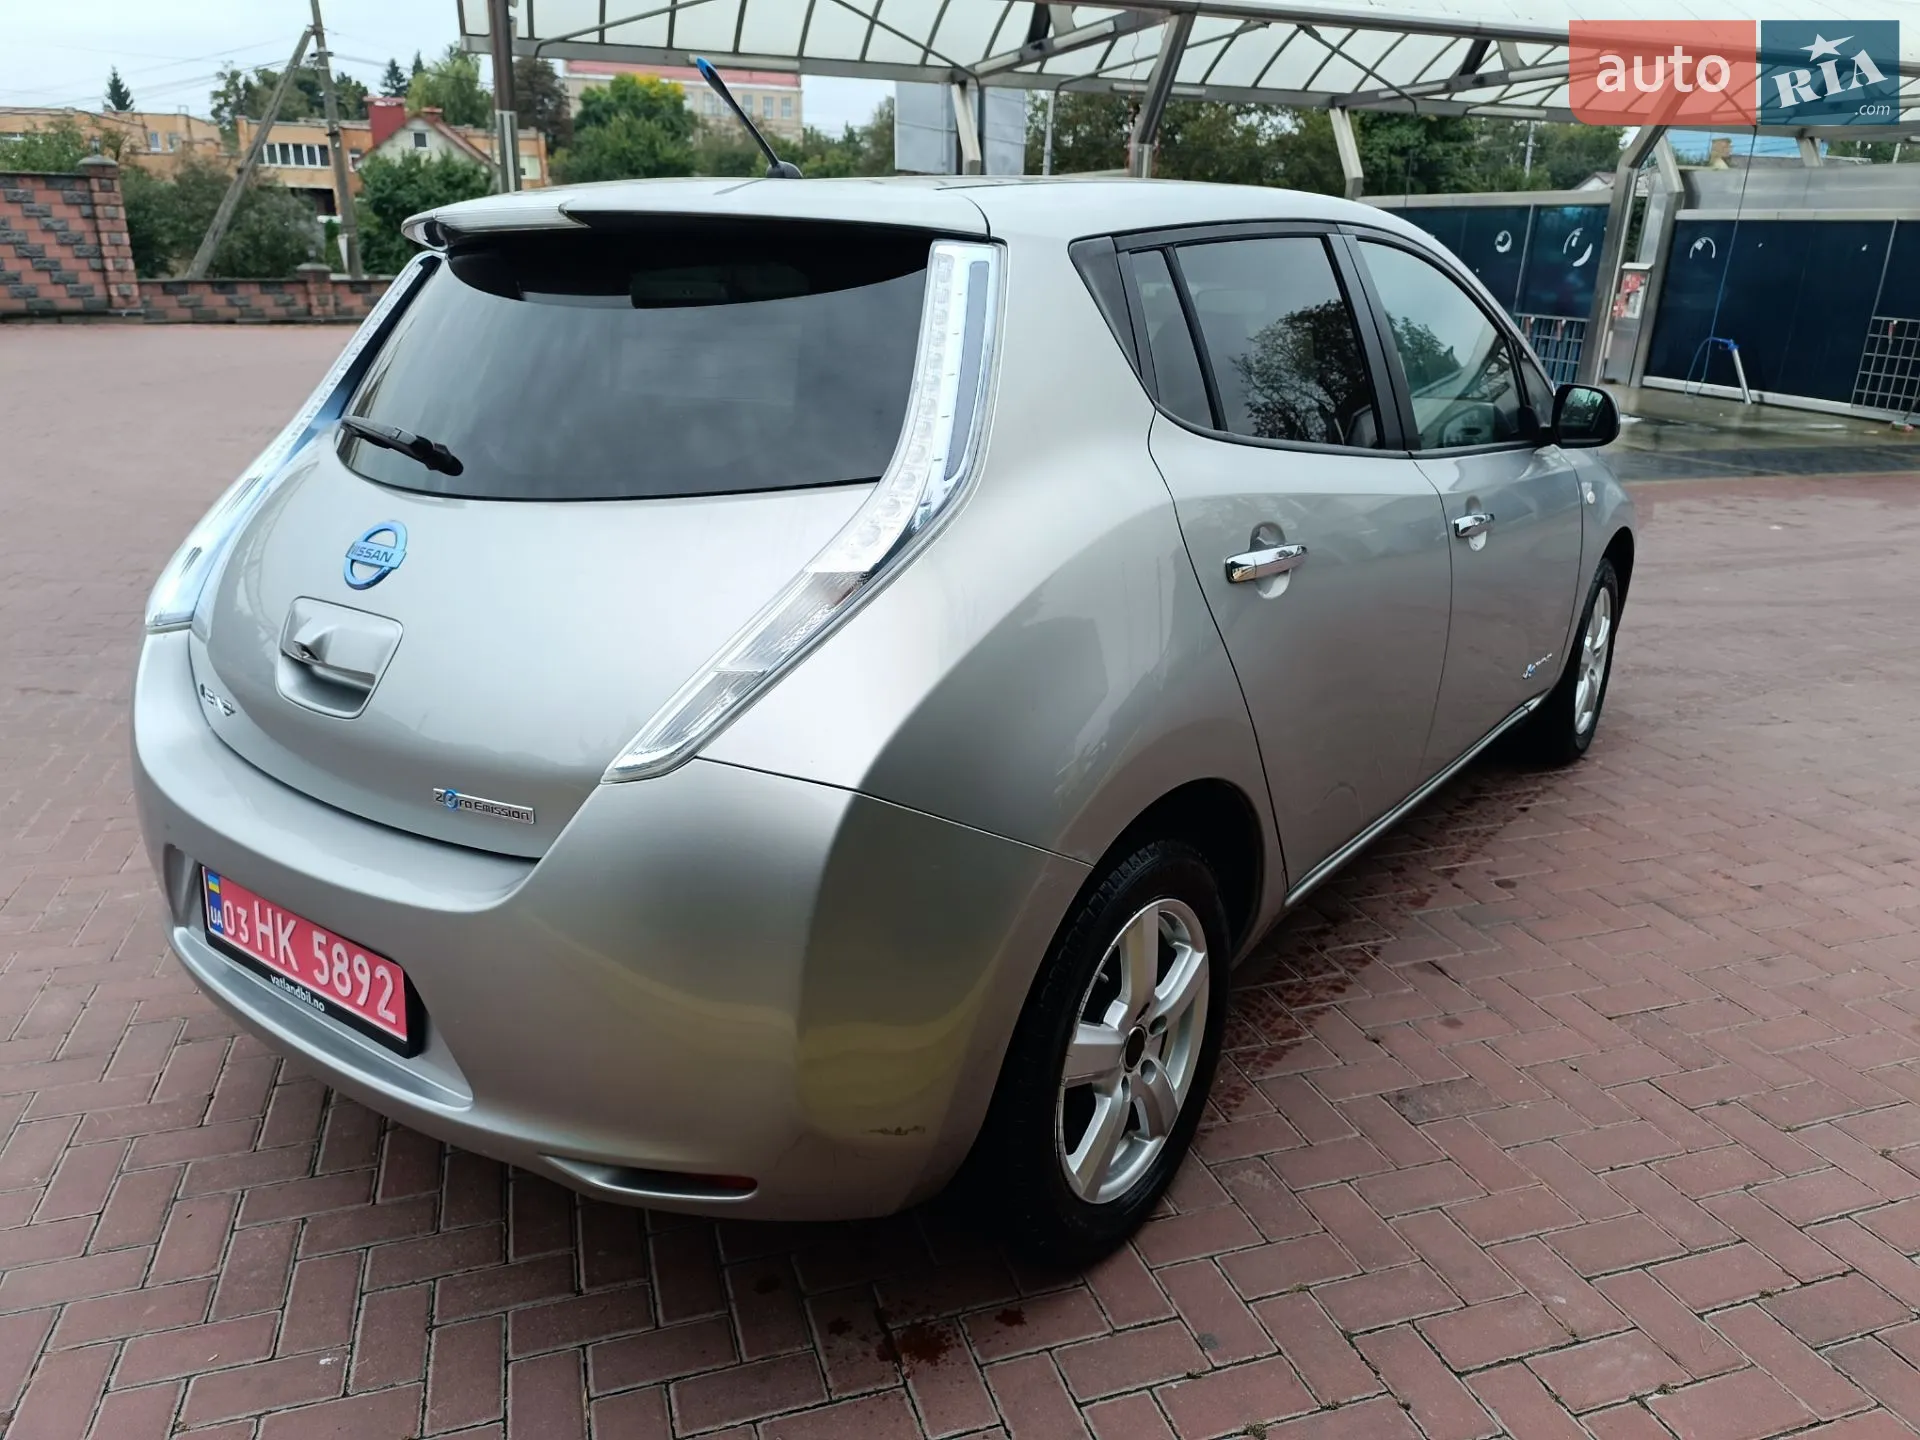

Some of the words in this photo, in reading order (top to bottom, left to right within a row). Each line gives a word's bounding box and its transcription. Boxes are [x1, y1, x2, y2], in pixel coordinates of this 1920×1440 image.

[351, 546, 394, 563] NISSAN
[210, 905, 223, 929] UA
[312, 930, 396, 1024] 5892
[271, 974, 325, 1012] vatlandbil.no
